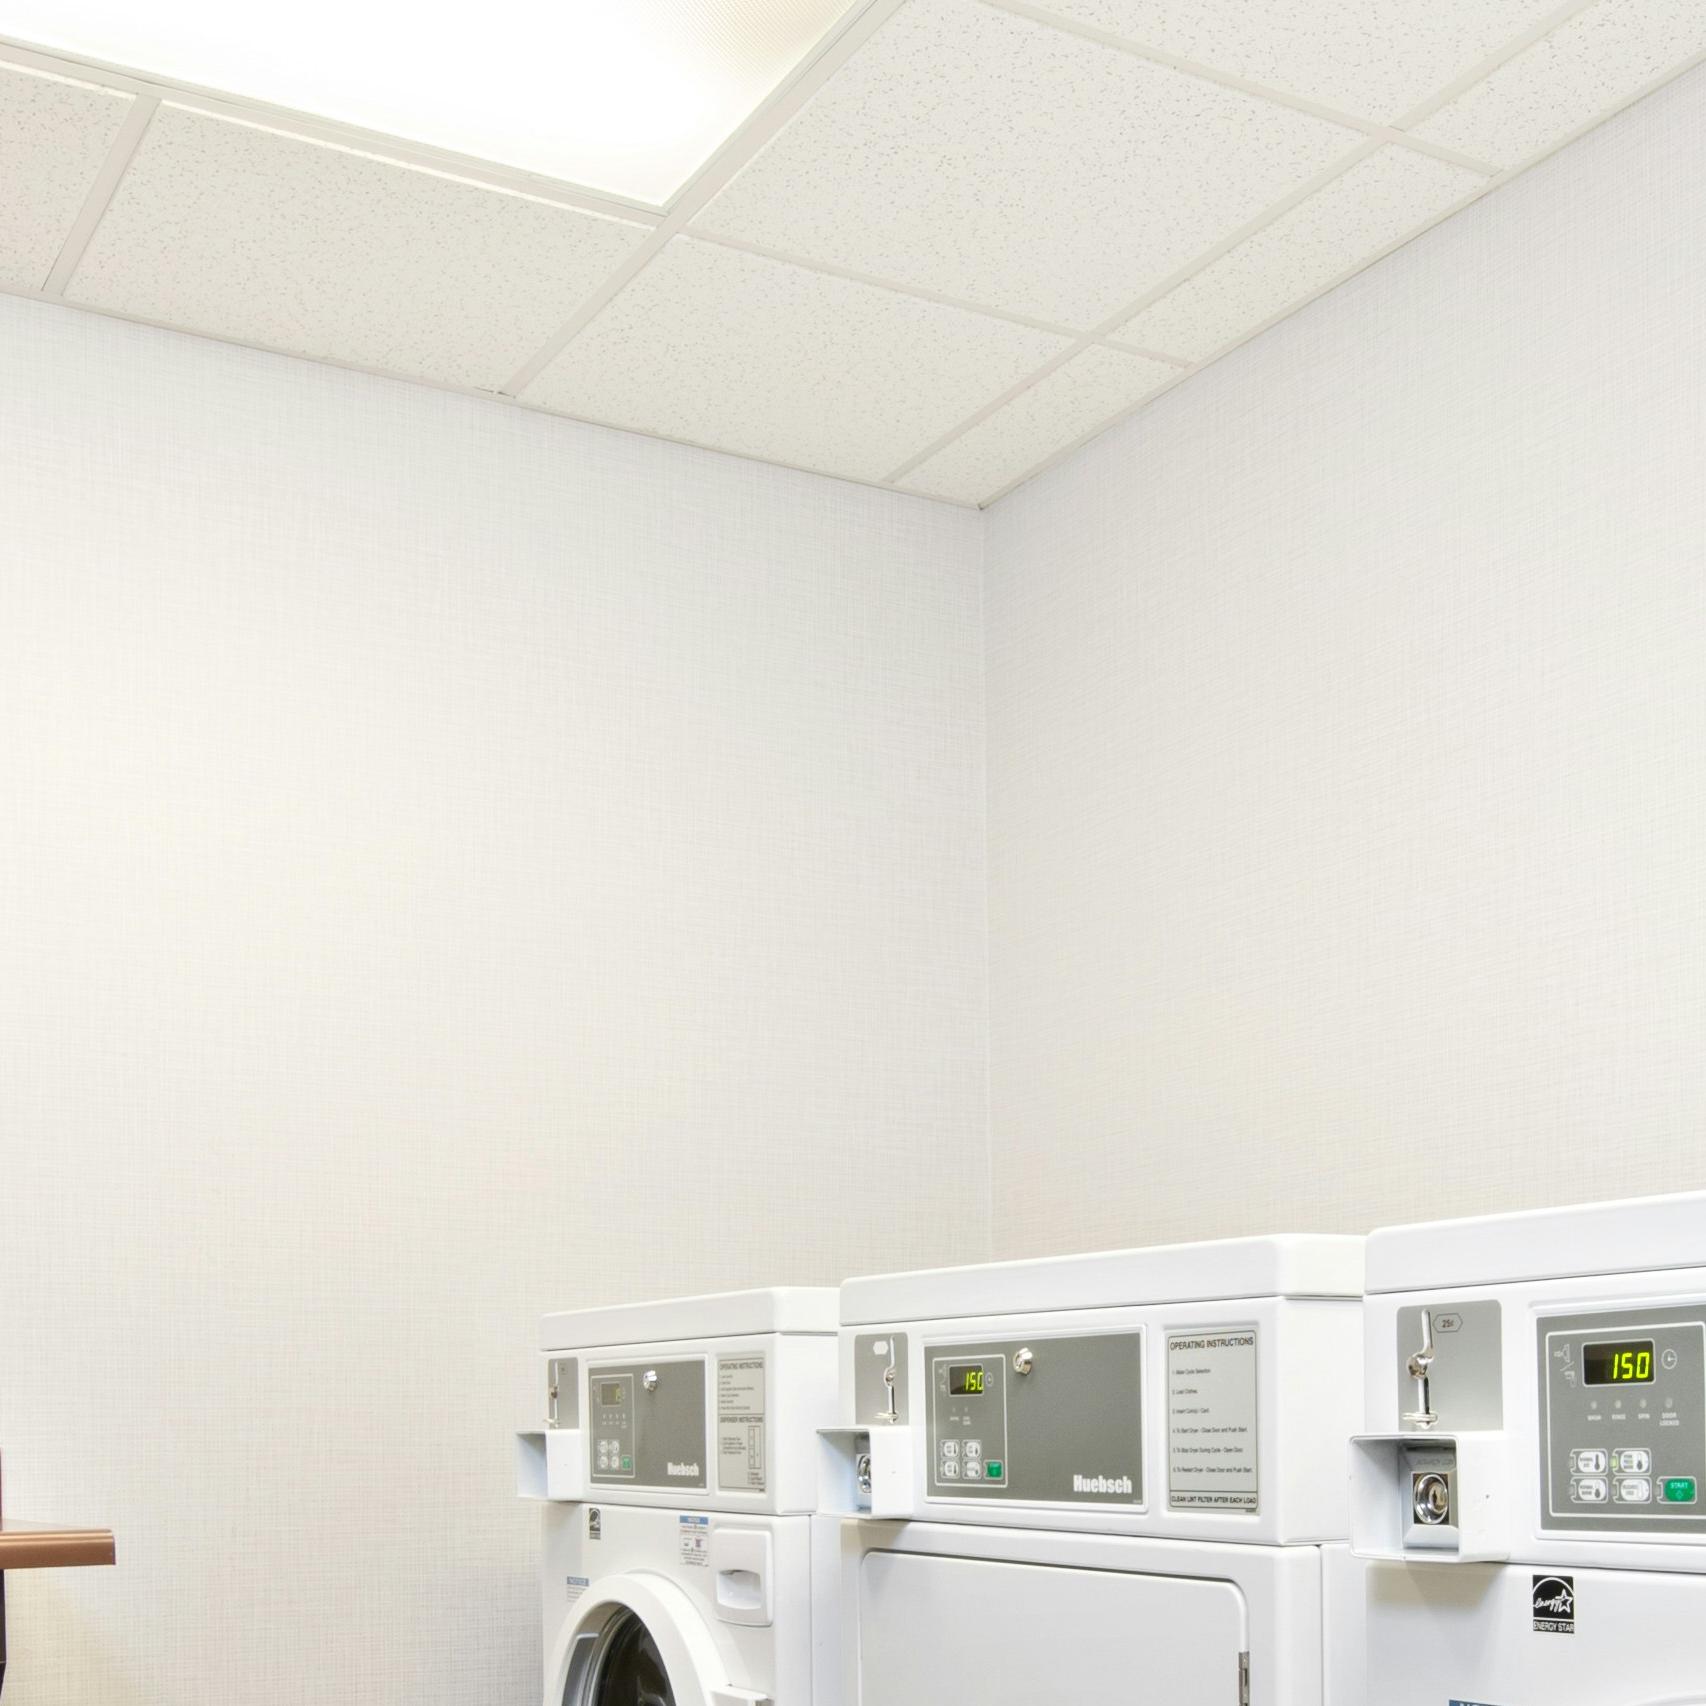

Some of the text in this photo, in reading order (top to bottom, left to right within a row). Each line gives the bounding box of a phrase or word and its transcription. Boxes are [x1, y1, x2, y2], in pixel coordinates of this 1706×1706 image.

[1170, 1337, 1253, 1350] OPERATING INSTRUCTIONS
[1613, 1352, 1650, 1379] 150
[667, 1462, 699, 1476] Huebsch
[1073, 1474, 1132, 1494] Huebsch
